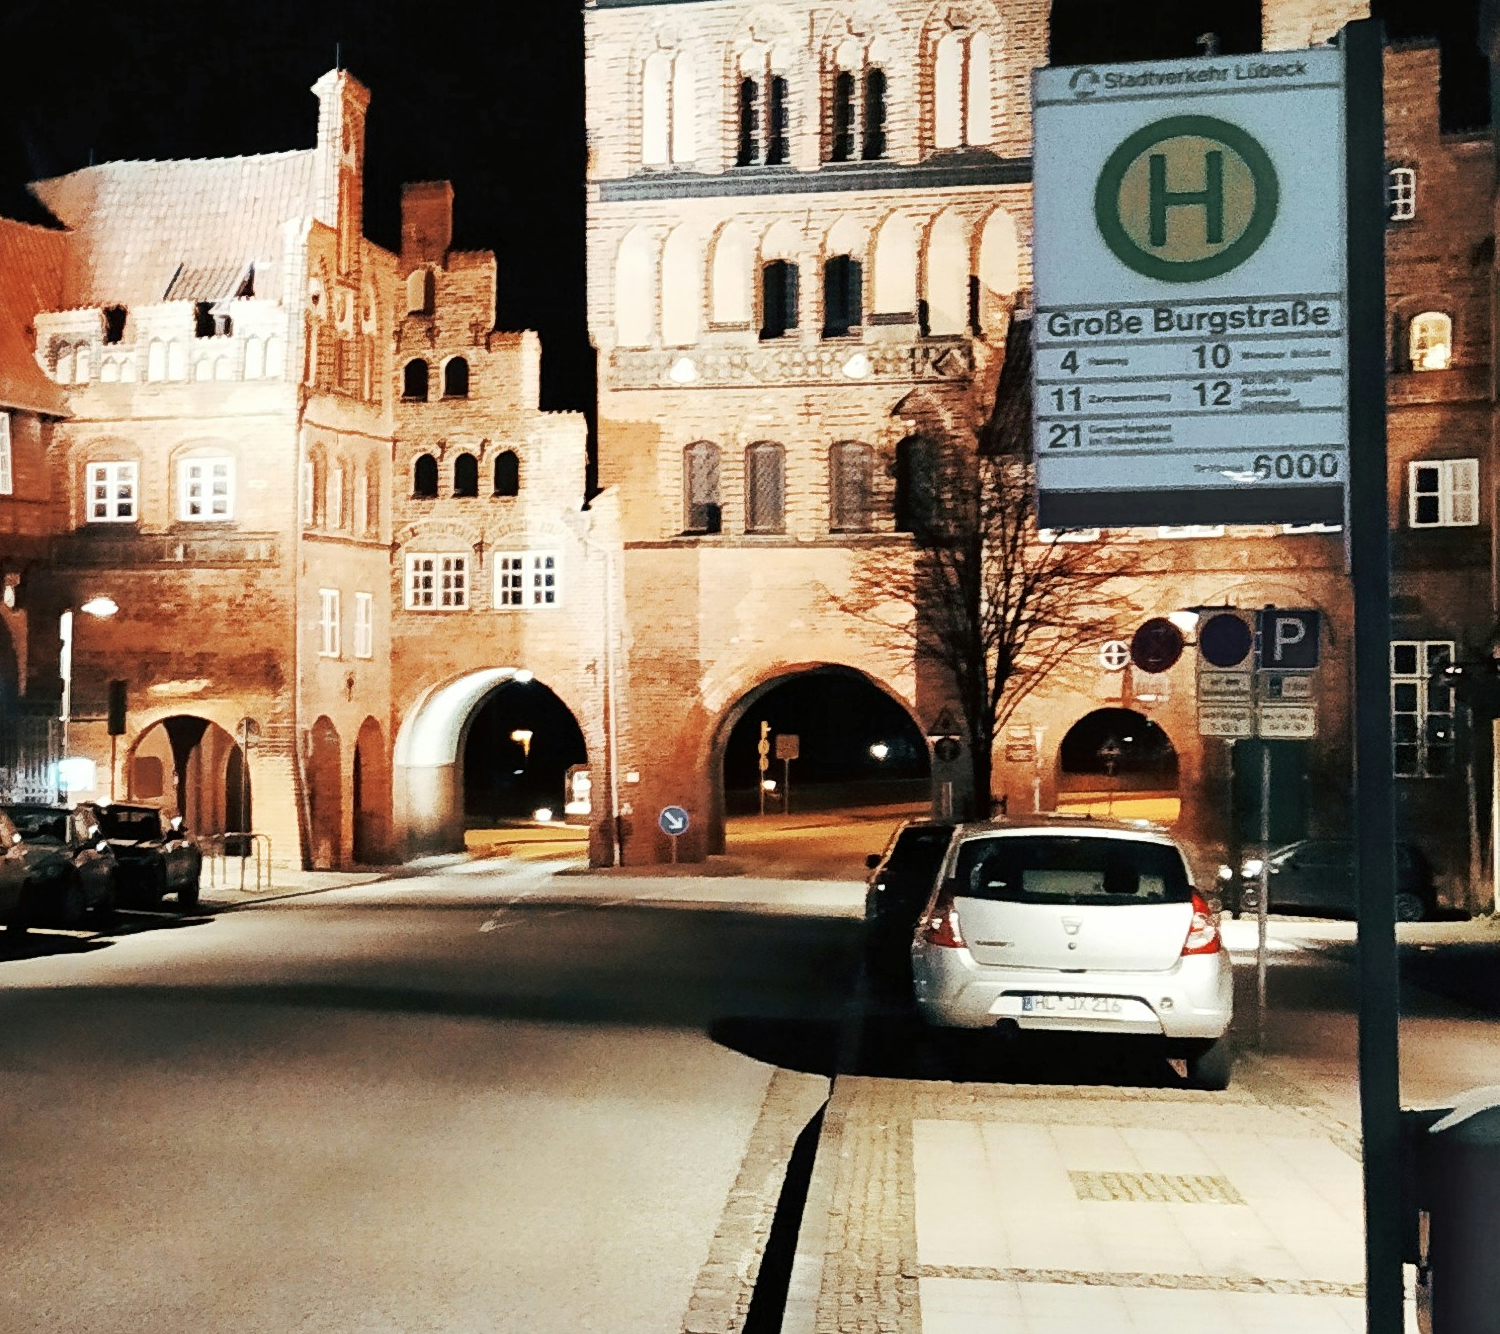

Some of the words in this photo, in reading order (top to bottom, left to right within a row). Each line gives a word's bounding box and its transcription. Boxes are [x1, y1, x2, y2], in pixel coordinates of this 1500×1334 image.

[1104, 65, 1229, 89] Stadtverkehr
[1235, 60, 1309, 81] Lübeck
[1149, 150, 1224, 247] H
[1047, 310, 1143, 337] Große
[1153, 301, 1331, 335] Burgstraße
[1060, 349, 1081, 374] 4
[1191, 343, 1232, 369] 10
[1050, 386, 1082, 411] 11
[1192, 380, 1232, 406] 12
[1048, 423, 1082, 449] 21
[1252, 452, 1338, 479] 6000
[1273, 617, 1306, 661] P
